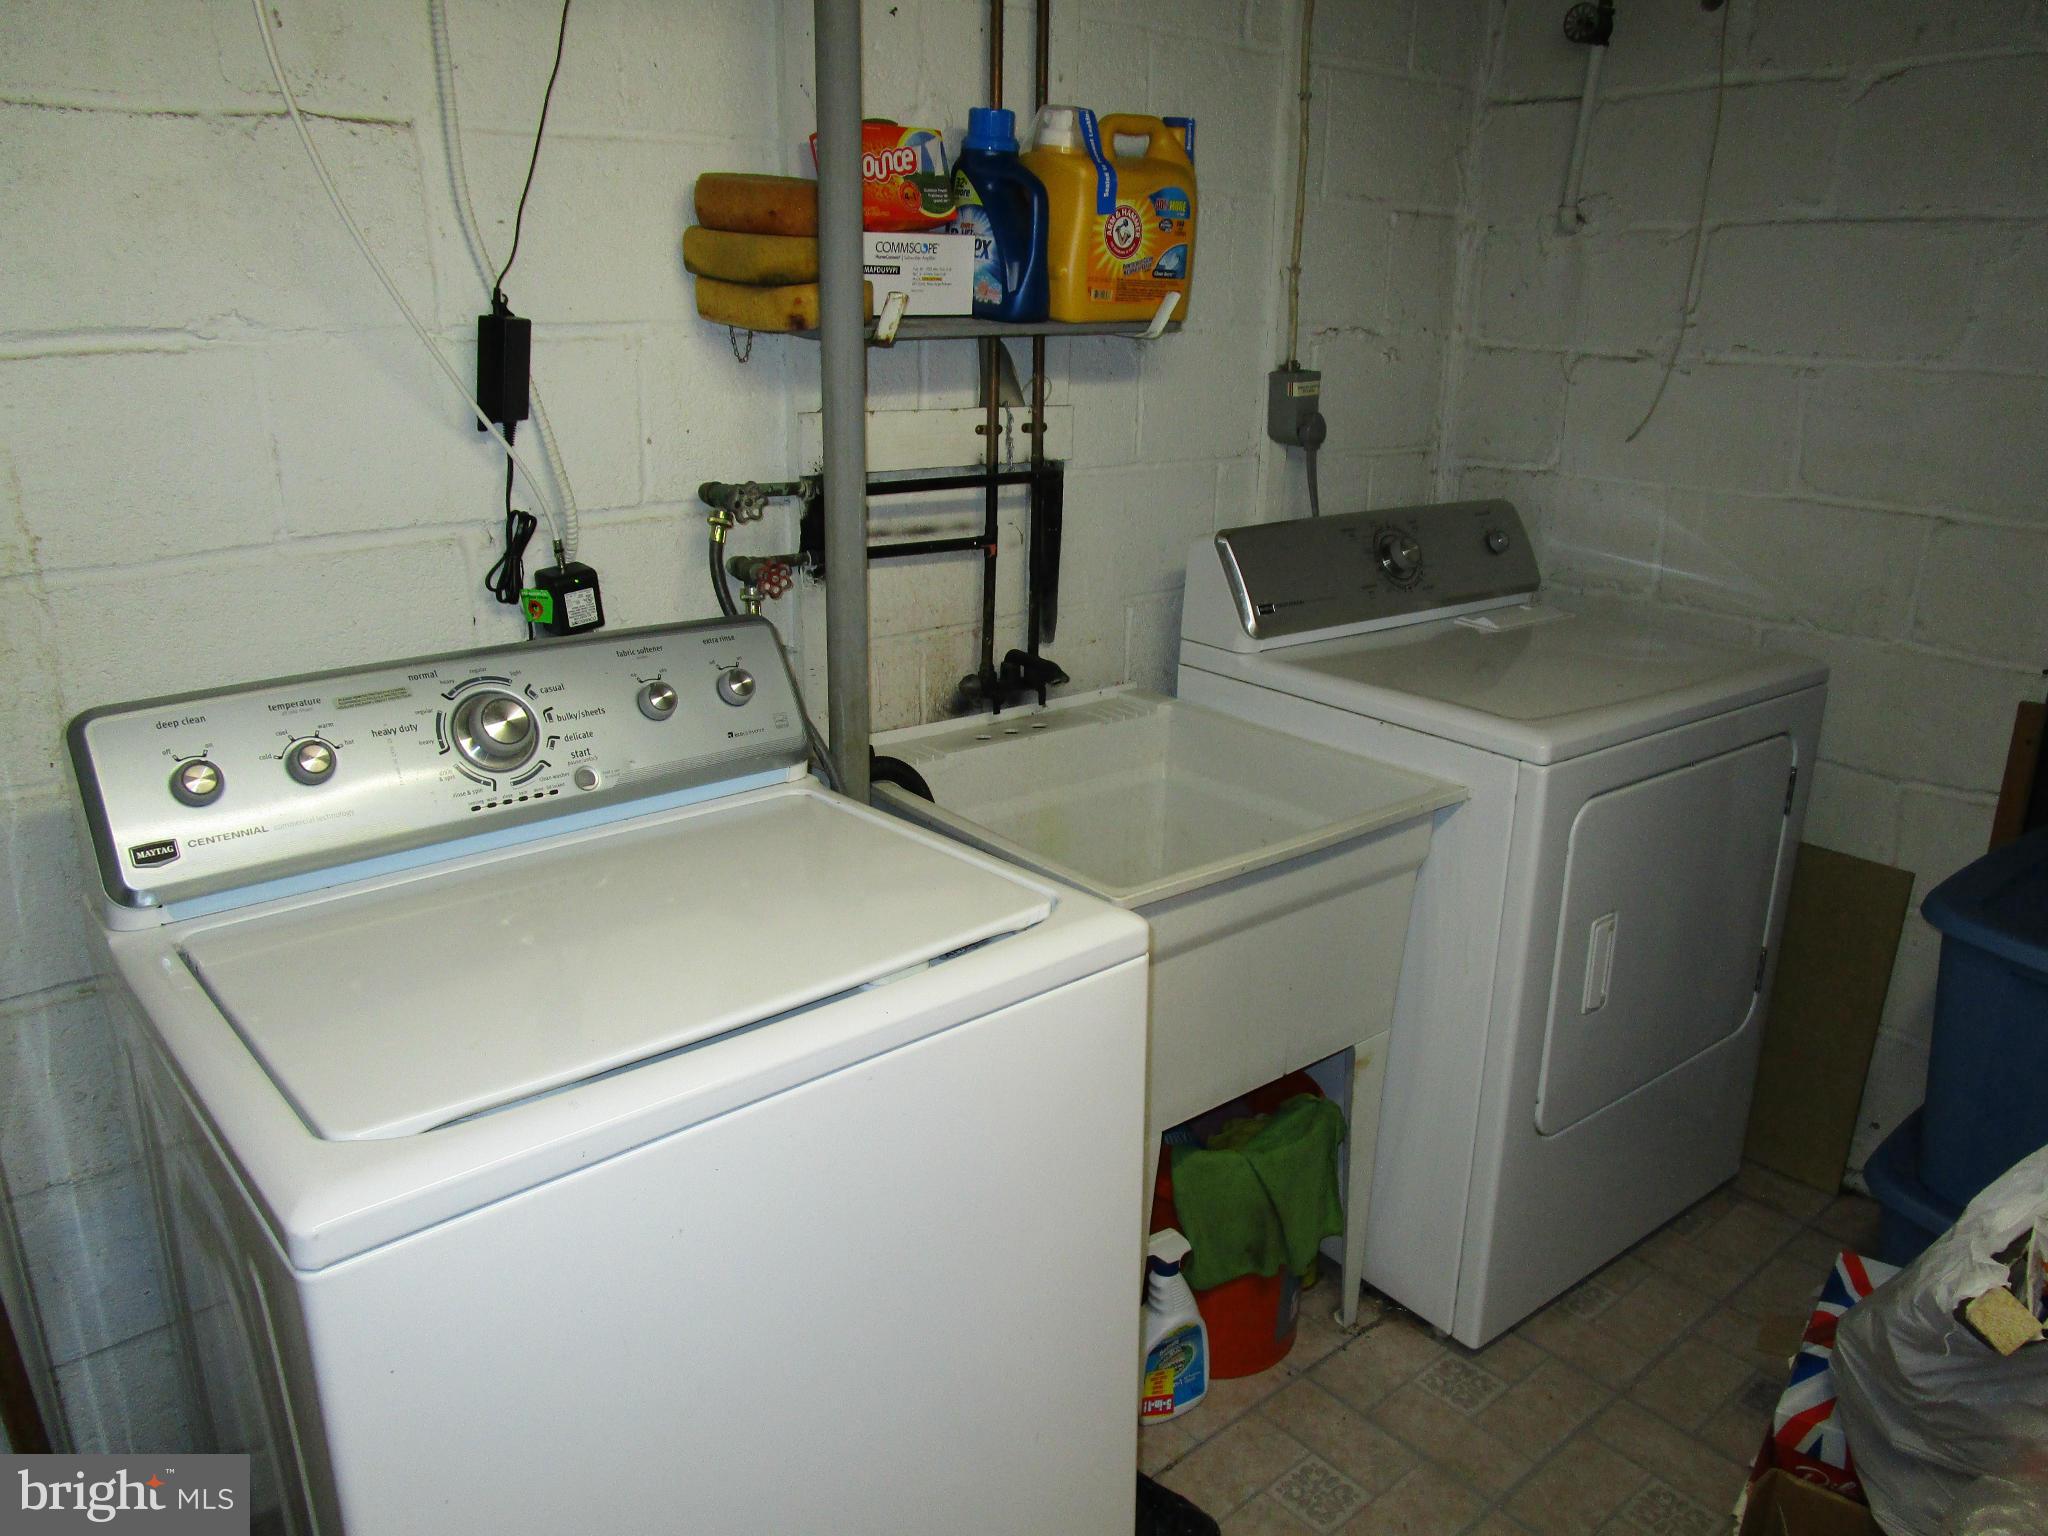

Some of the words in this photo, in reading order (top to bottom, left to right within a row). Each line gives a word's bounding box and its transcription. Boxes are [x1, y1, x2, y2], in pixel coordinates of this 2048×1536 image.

[863, 148, 914, 180] ounce
[1107, 216, 1117, 237] ARM
[1121, 208, 1141, 238] HAMMER
[875, 241, 938, 255] COMMSCOPE
[702, 637, 719, 645] extra
[616, 648, 636, 657] fabric
[637, 645, 663, 655] softener
[408, 669, 438, 681] normal
[540, 683, 565, 694] casual
[268, 697, 321, 711] temperature
[556, 707, 606, 722] bulky/sheets
[156, 720, 179, 730] deep
[181, 715, 207, 726] clean
[371, 727, 397, 738] heavy
[399, 723, 418, 733] duty
[564, 731, 593, 742] delicate
[161, 748, 171, 756] off
[259, 753, 272, 761] cold
[571, 748, 591, 759] start
[135, 845, 175, 860] MAYTAG
[187, 825, 270, 848] CENTENNIAL
